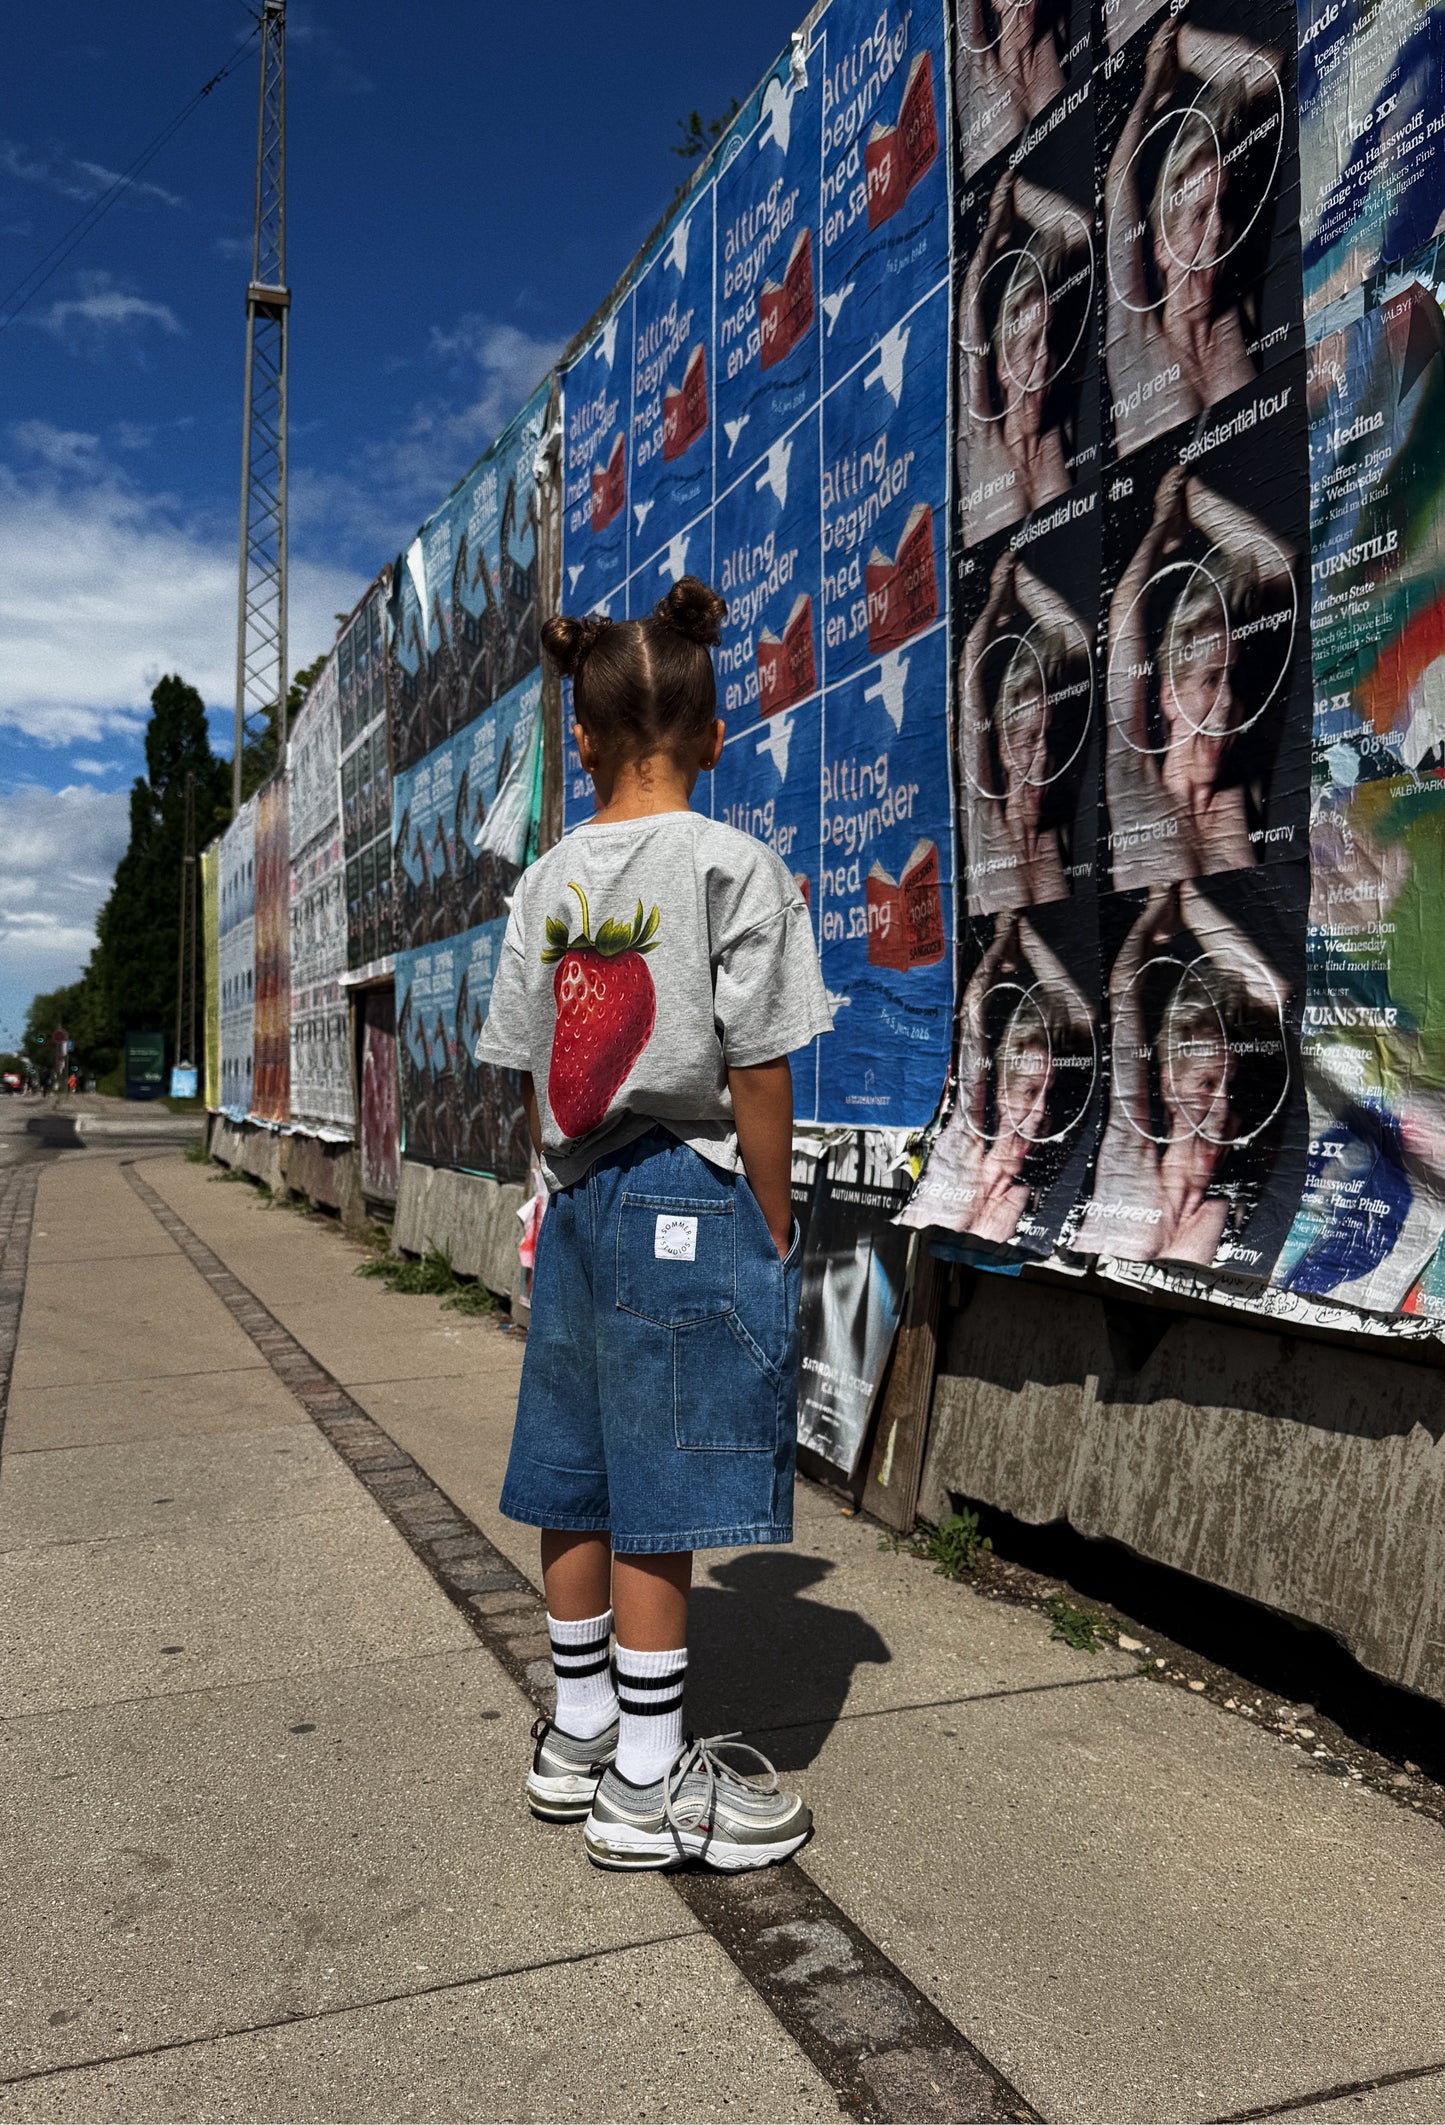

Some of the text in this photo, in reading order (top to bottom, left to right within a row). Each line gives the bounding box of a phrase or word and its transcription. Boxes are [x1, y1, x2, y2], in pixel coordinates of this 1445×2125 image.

[1297, 2, 1340, 51] Lorde
[823, 8, 887, 116] alting
[1068, 32, 1091, 62] romy
[1313, 37, 1346, 69] Iceage
[1316, 24, 1379, 81] Tash Sultana
[1103, 51, 1126, 80] the
[1374, 67, 1401, 95] AUGUST
[822, 9, 912, 157] begynder
[1298, 97, 1316, 116] Alba
[1376, 93, 1397, 124] xx
[1008, 98, 1067, 170] sexistential
[1067, 79, 1092, 109] tour
[1415, 145, 1436, 167] Fine
[1315, 185, 1351, 217] Orange
[1358, 158, 1389, 186] Geese
[1397, 133, 1424, 160] Hans
[1317, 174, 1343, 201] Anna
[1345, 160, 1364, 180] von
[824, 152, 891, 247] en sang
[1320, 213, 1358, 247] Horsegirl
[1363, 195, 1385, 218] Tyler
[1386, 168, 1425, 201] Ballgame
[725, 180, 777, 262] alting
[724, 188, 799, 299] begynder
[637, 300, 677, 365] alting
[721, 290, 755, 347] med
[727, 306, 778, 379] en sang
[1260, 322, 1290, 351] romy
[636, 308, 695, 398] begynder
[1110, 363, 1181, 422] royal arena
[633, 391, 661, 438] med
[1327, 403, 1354, 422] AUGUST
[637, 408, 678, 467] en sang
[1111, 387, 1292, 502] the sexistential tour
[1325, 410, 1385, 455] Medina
[1075, 444, 1097, 467] romy
[1321, 446, 1392, 488] Sniffers Dijon
[822, 432, 887, 511] alting
[1326, 467, 1384, 503] Wednesday
[821, 451, 915, 554] begynder
[957, 469, 1016, 514] royal arena
[1329, 483, 1389, 521] Kind Kind
[958, 492, 1098, 579] the sexistential tour
[1328, 528, 1354, 549] AUGUST
[721, 530, 775, 592] alting
[1311, 529, 1398, 583] TURNSTILE
[1349, 581, 1376, 600] State
[826, 614, 845, 648] en
[849, 583, 889, 639] sang
[1340, 600, 1370, 622] Wilco
[1353, 611, 1393, 635] Dove Ellis
[1176, 632, 1222, 665] robyn
[1231, 608, 1293, 641] copenhagen
[718, 630, 753, 676] med
[725, 658, 777, 711] en sang
[1328, 667, 1355, 683] AUGUST
[1047, 679, 1090, 705] copenhagen
[1330, 691, 1351, 712] xx
[1360, 737, 1380, 756] 08
[822, 753, 887, 802] alting
[821, 783, 919, 856] begynder
[1264, 825, 1295, 844] romy
[1072, 863, 1093, 877] romy
[823, 900, 891, 941] en sang
[1319, 921, 1396, 938] Sniffers Dijon
[1324, 938, 1387, 955] Wednesday
[1325, 960, 1345, 971] Kind
[1347, 960, 1369, 971] mod
[1302, 1006, 1398, 1028] TURNSTILE
[1052, 1053, 1093, 1070] copenhagen
[1229, 1038, 1284, 1057] copenhagen
[1343, 1046, 1373, 1060] State
[1327, 1060, 1364, 1076] Wilco
[1321, 1142, 1345, 1158] xx
[791, 1188, 808, 1202] TOUR
[831, 1187, 860, 1203] AUTUMN
[860, 1192, 881, 1206] LIGHT
[1304, 1174, 1365, 1194] Hausswolff
[1081, 1199, 1122, 1223] royal
[1331, 1193, 1391, 1218] Hans Philip
[661, 1221, 692, 1236] SOMMER
[1027, 1226, 1048, 1240] romy
[660, 1241, 691, 1255] STUDIOS
[1229, 1246, 1263, 1266] romy
